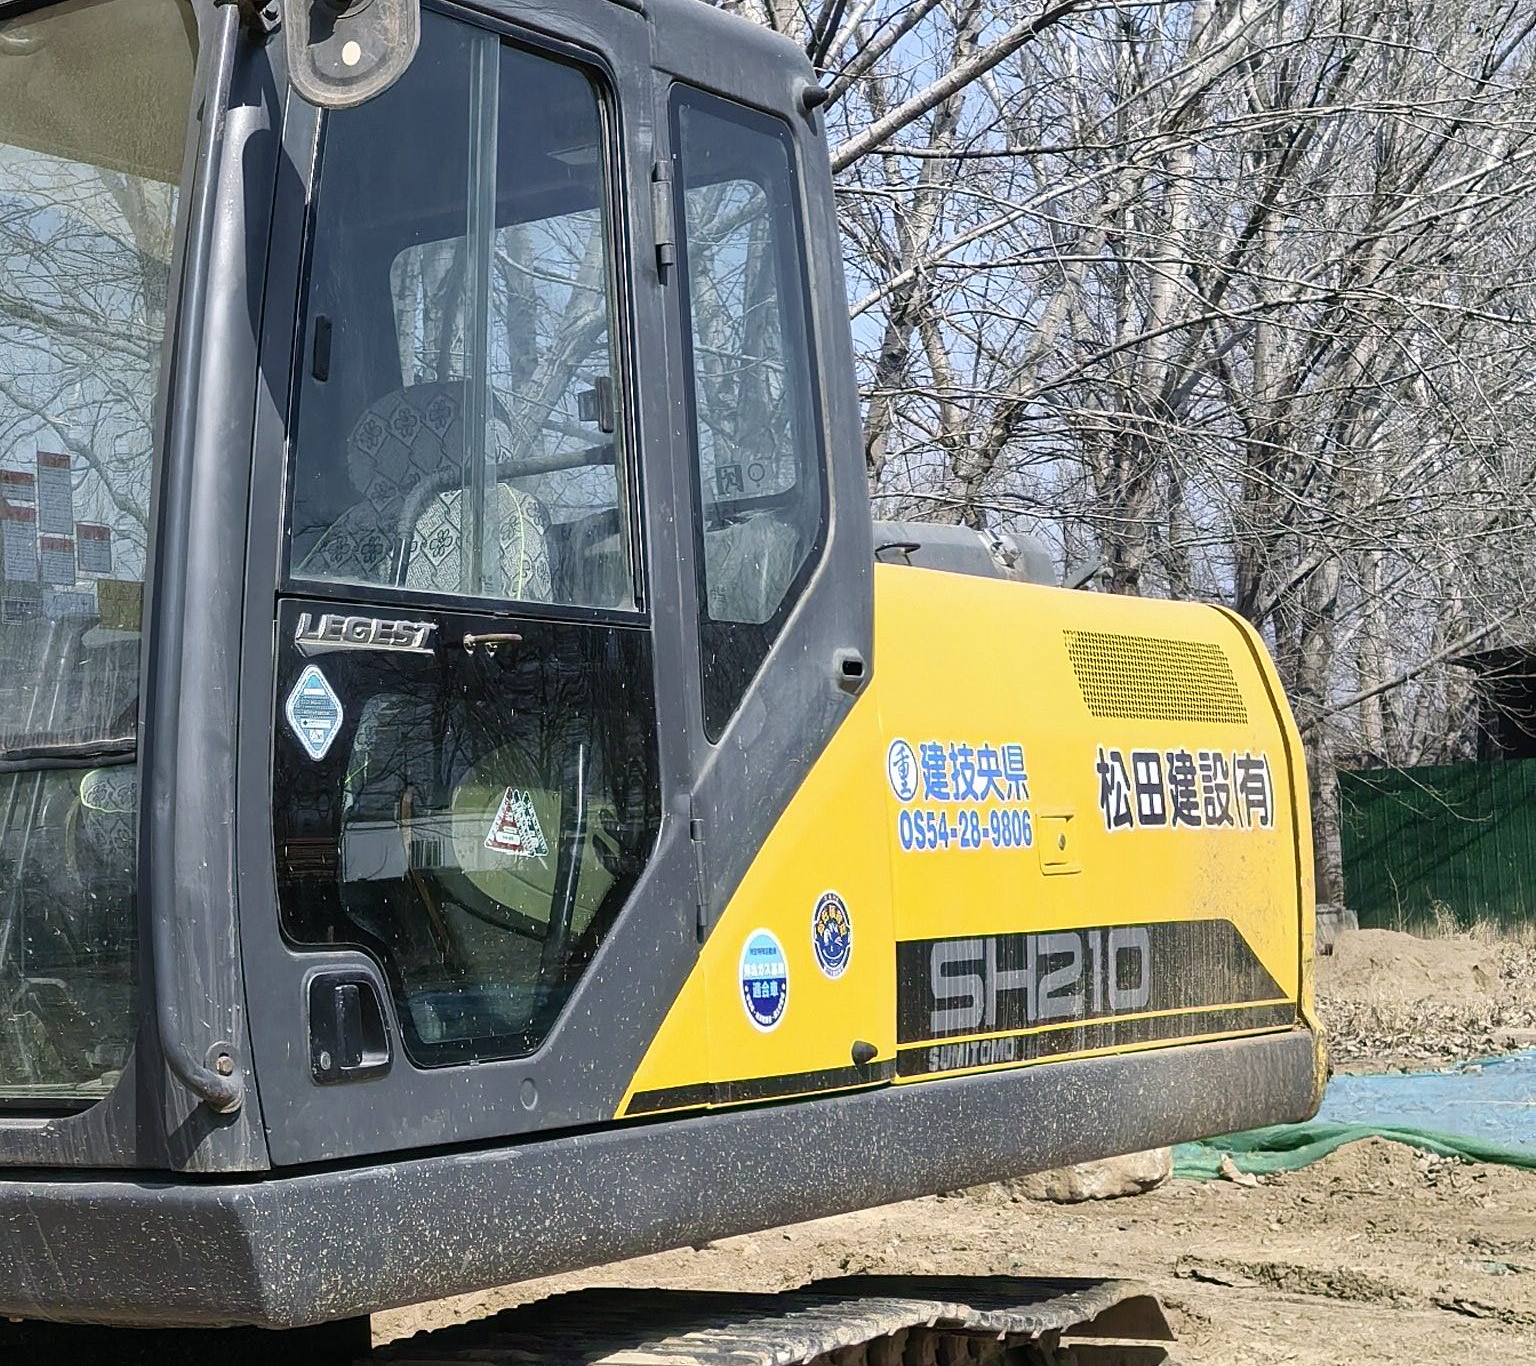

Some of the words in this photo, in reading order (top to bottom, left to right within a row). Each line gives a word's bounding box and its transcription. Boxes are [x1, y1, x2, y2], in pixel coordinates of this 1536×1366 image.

[295, 612, 439, 649] LEGEST
[929, 926, 1151, 1033] SH210
[927, 1036, 1015, 1072] SUMITOMO
